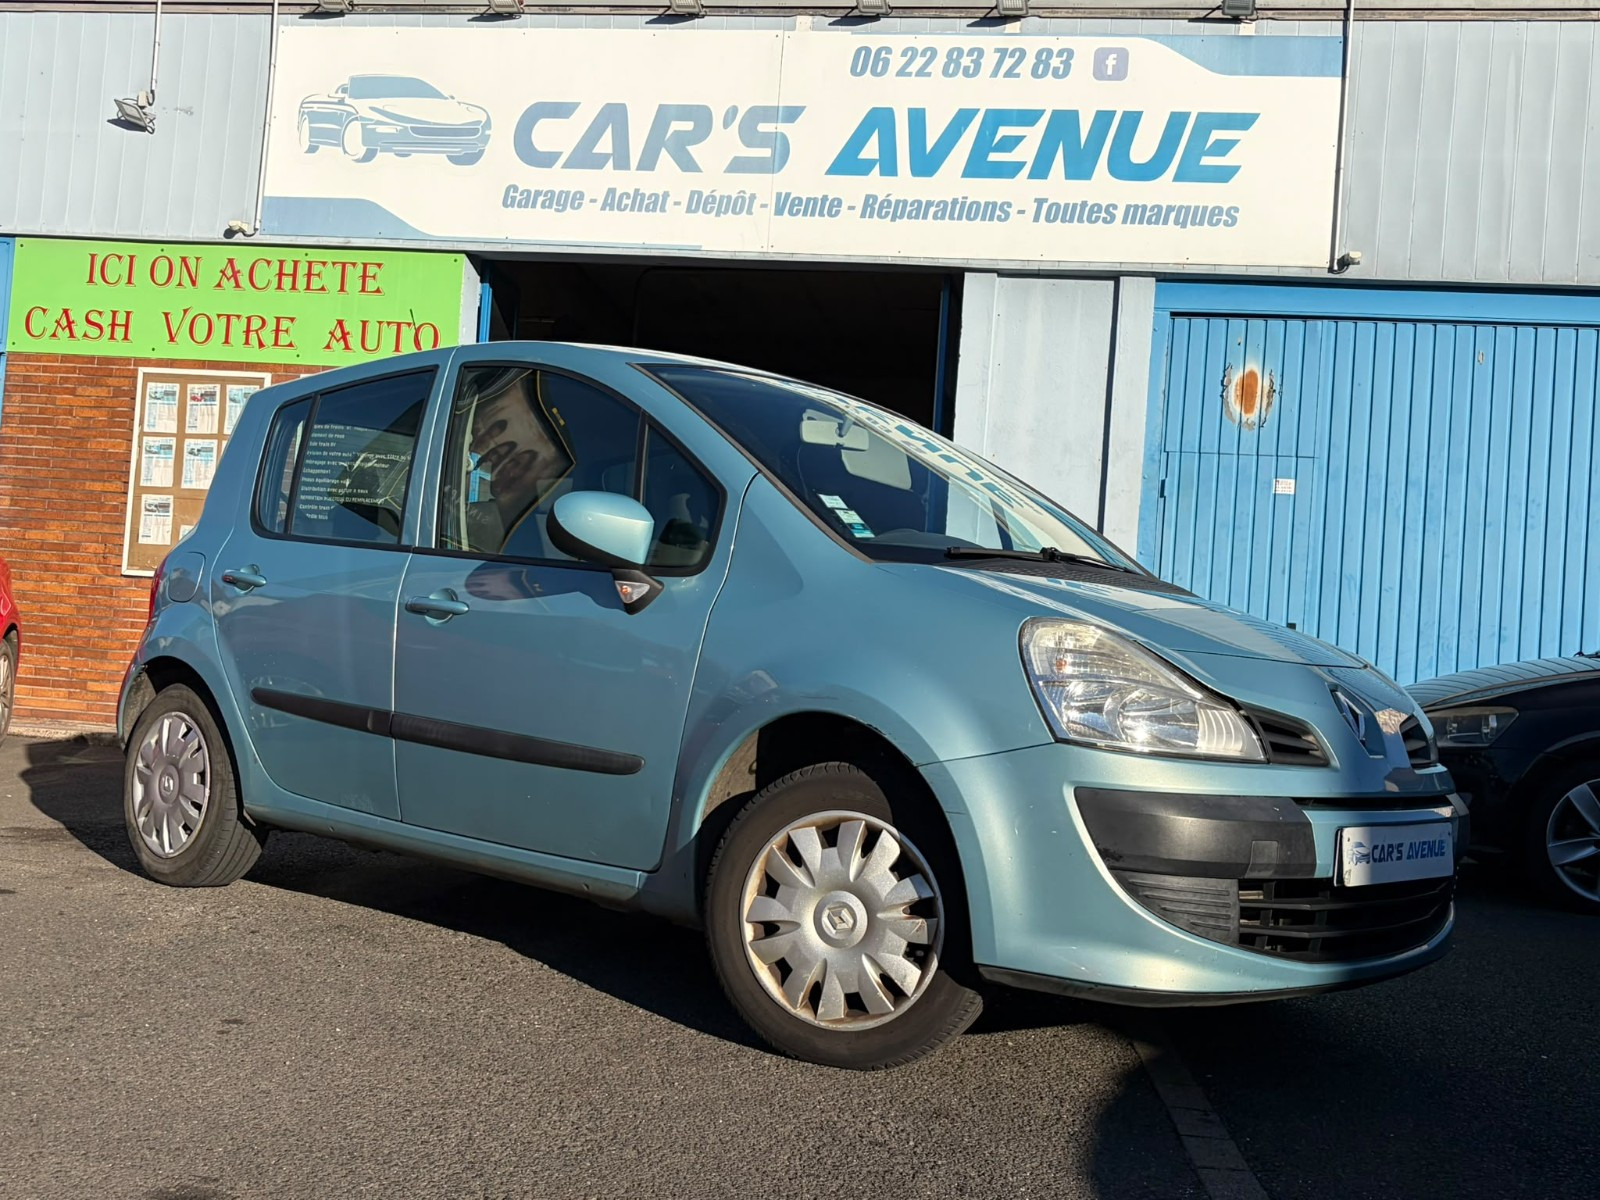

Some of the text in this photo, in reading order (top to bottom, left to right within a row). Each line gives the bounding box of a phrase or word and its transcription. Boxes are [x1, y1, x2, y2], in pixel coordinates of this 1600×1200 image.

[850, 46, 1075, 80] 06 22 83 72 83
[513, 101, 1261, 184] CAR'S AVENUE
[502, 184, 586, 213] Garage
[601, 187, 669, 213] Achat
[685, 189, 755, 218] Dépôt
[774, 192, 843, 218] Vente
[860, 194, 1013, 224] Réparations
[1033, 197, 1118, 226] Toutes
[1121, 204, 1240, 229] marques
[86, 253, 386, 297] ICI ON ACHETE
[24, 306, 441, 354] CASH VOTRE AUTO
[1371, 839, 1446, 863] CAR'S AVENUE
